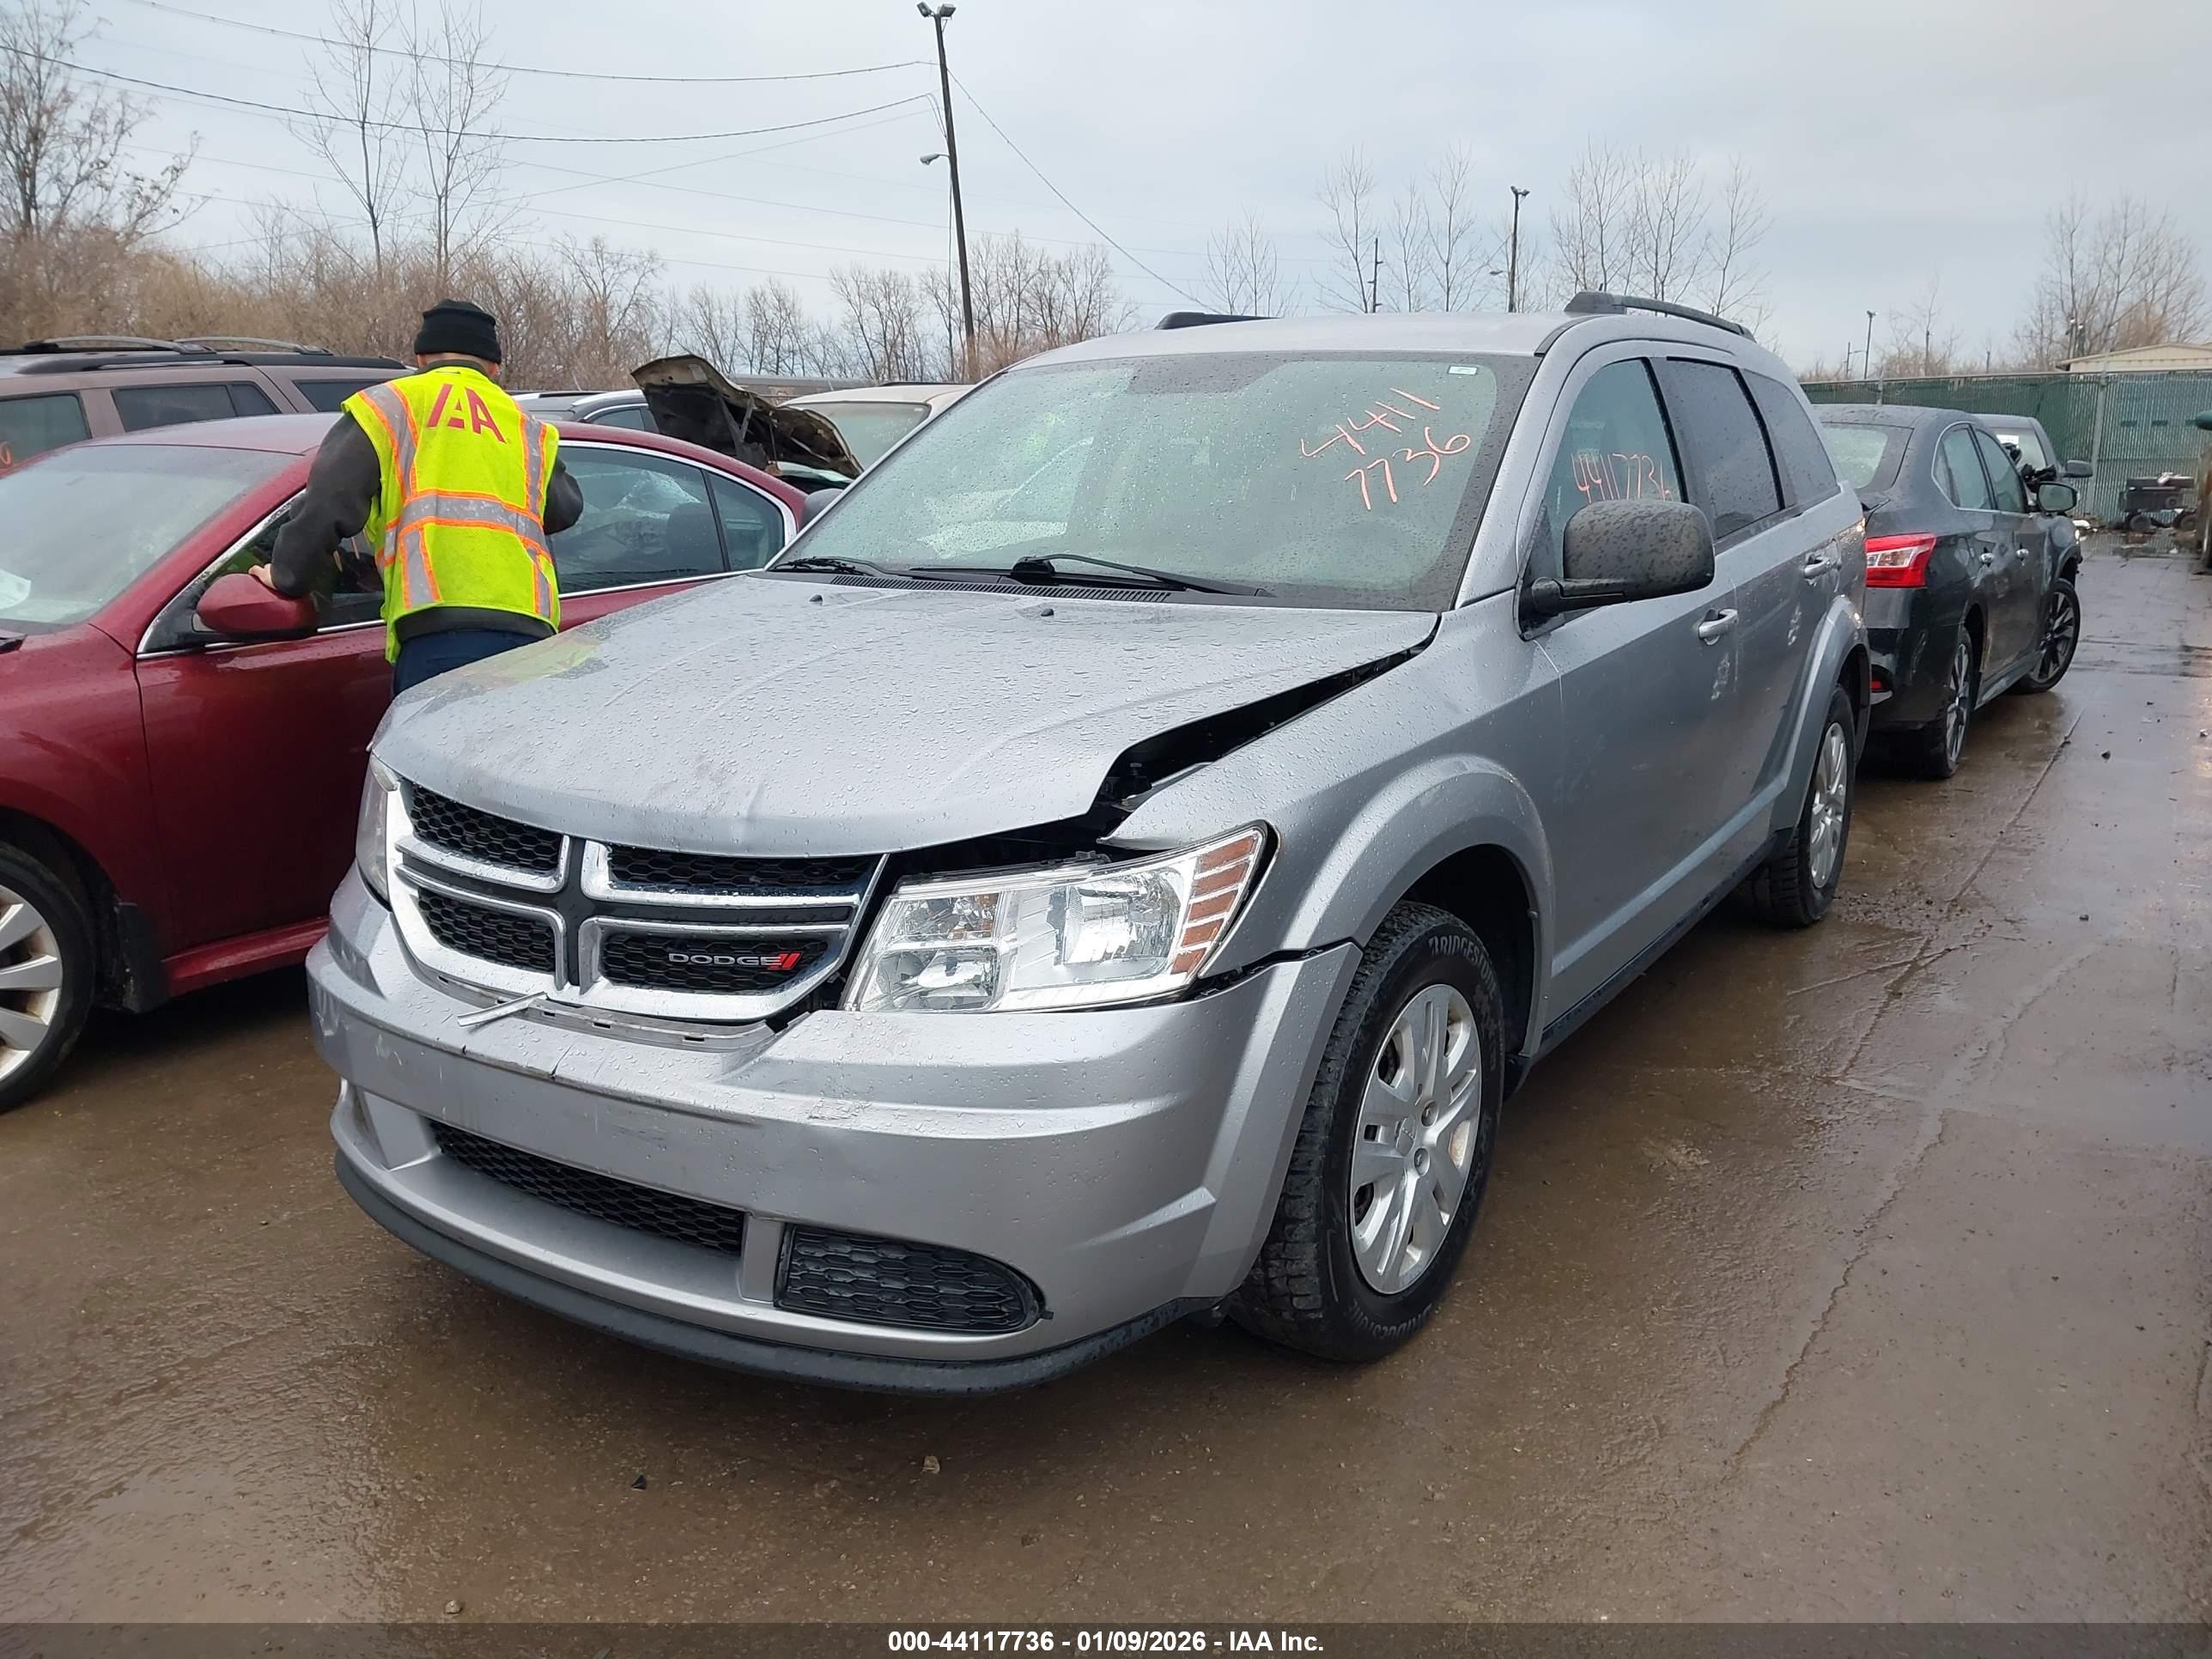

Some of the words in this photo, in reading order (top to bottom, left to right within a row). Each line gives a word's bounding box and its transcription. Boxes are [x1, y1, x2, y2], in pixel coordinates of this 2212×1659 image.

[427, 383, 507, 444] IAA
[1300, 387, 1441, 457] 4411
[1344, 426, 1471, 510] 7736
[668, 952, 782, 966] DODGE
